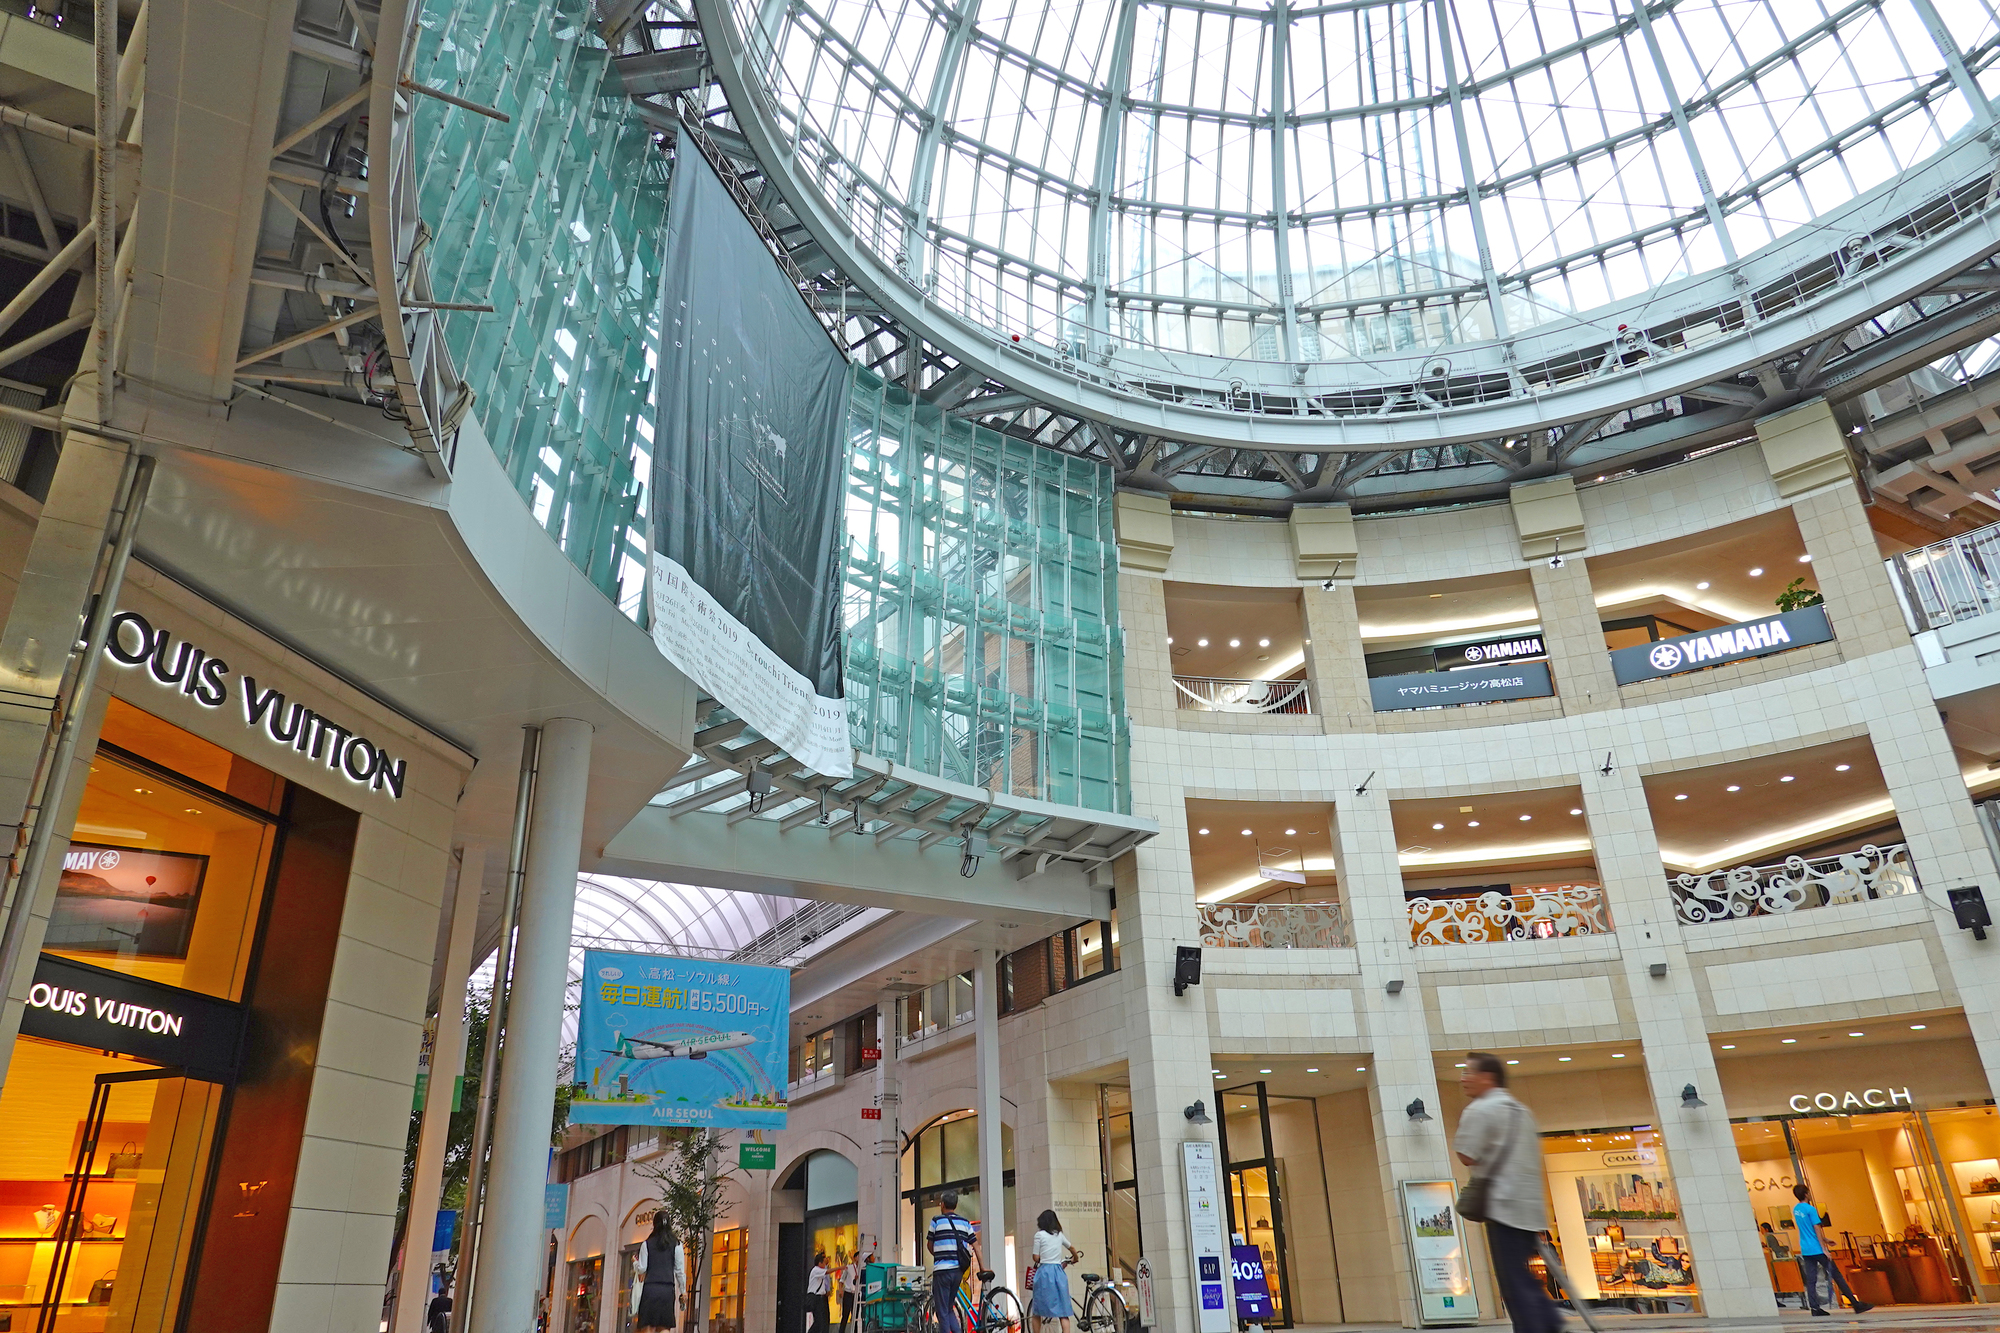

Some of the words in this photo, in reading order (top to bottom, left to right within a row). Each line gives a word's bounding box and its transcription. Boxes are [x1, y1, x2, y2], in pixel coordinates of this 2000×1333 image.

[1482, 638, 1543, 659] YAMAHA
[1680, 620, 1791, 664] YAMAHA
[1397, 676, 1524, 697] ヤマハミュージック高松店
[813, 704, 841, 721] 2019
[241, 675, 407, 799] VUITTON
[25, 983, 87, 1016] OUIS
[95, 996, 184, 1037] VUITTON
[698, 1033, 731, 1045] SEOUL
[1788, 1086, 1913, 1113] COACH
[652, 1108, 673, 1118] AIR
[675, 1108, 713, 1119] SEOUL
[1608, 1153, 1651, 1163] COACH
[1744, 1176, 1794, 1192] OAC
[1203, 1263, 1216, 1275] GAP
[1232, 1261, 1263, 1280] 40%
